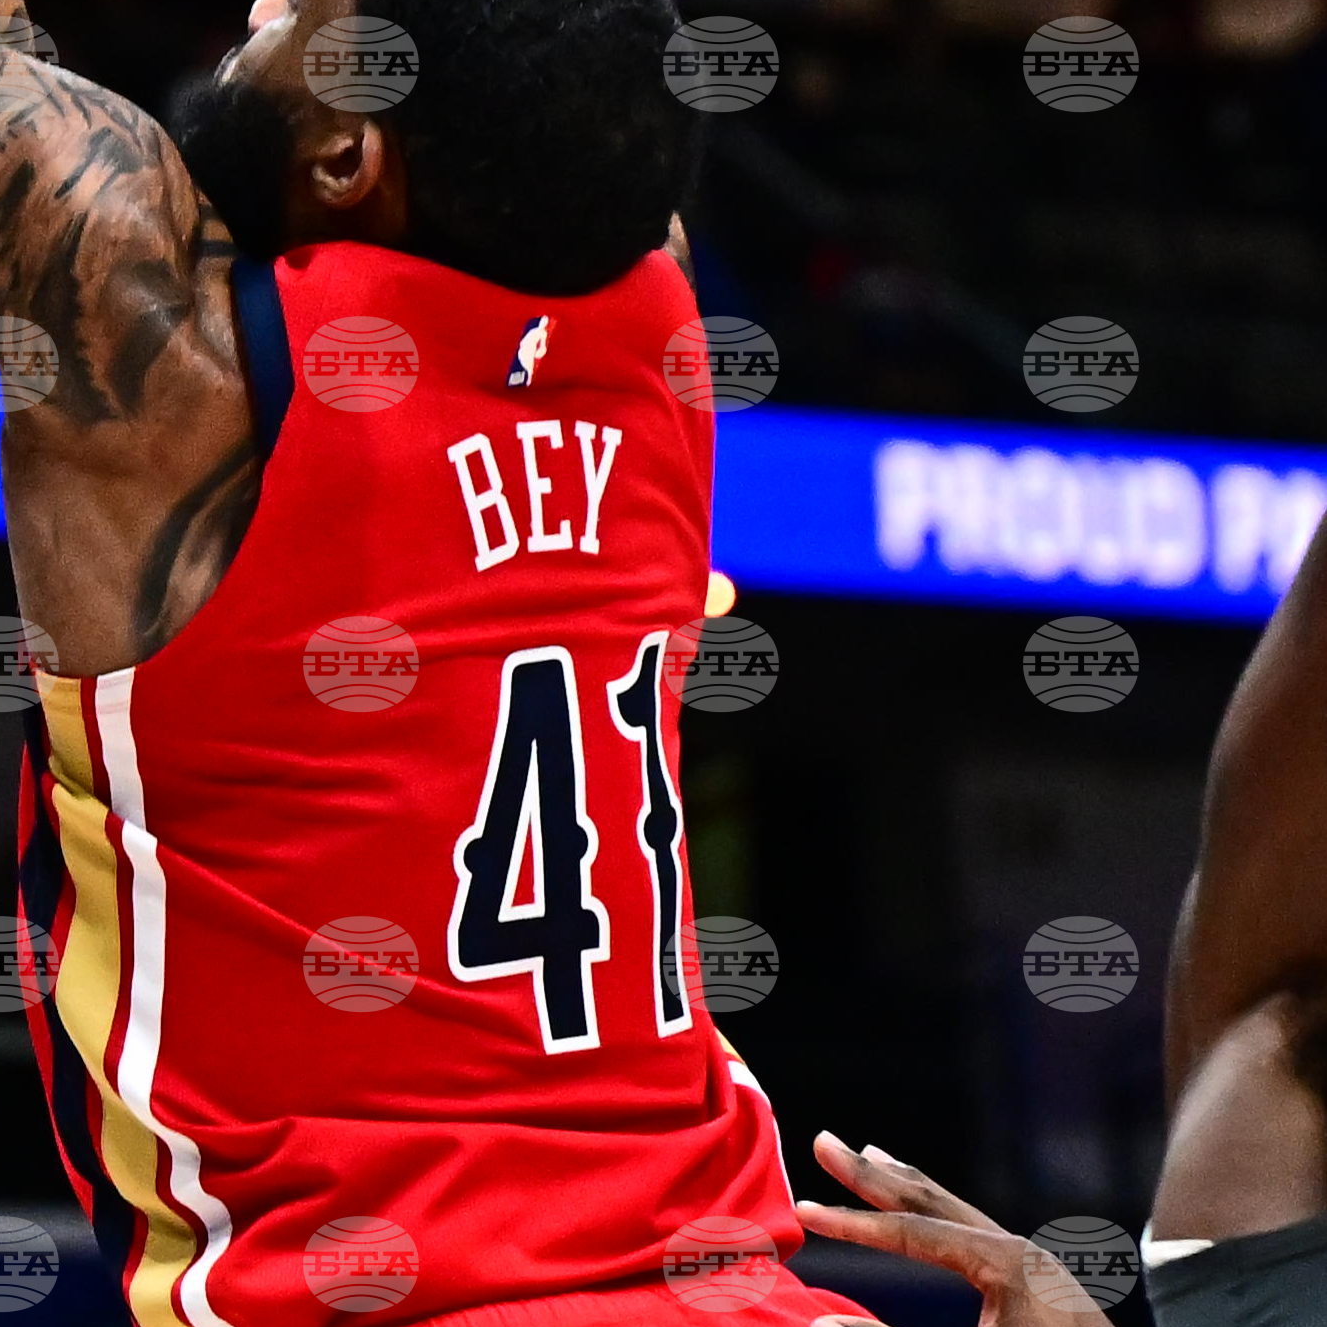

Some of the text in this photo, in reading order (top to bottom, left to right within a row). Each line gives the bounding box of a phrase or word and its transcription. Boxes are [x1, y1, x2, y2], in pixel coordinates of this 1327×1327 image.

[448, 420, 622, 572] BEY
[874, 438, 1206, 588] PROUD
[448, 629, 693, 1056] 41
